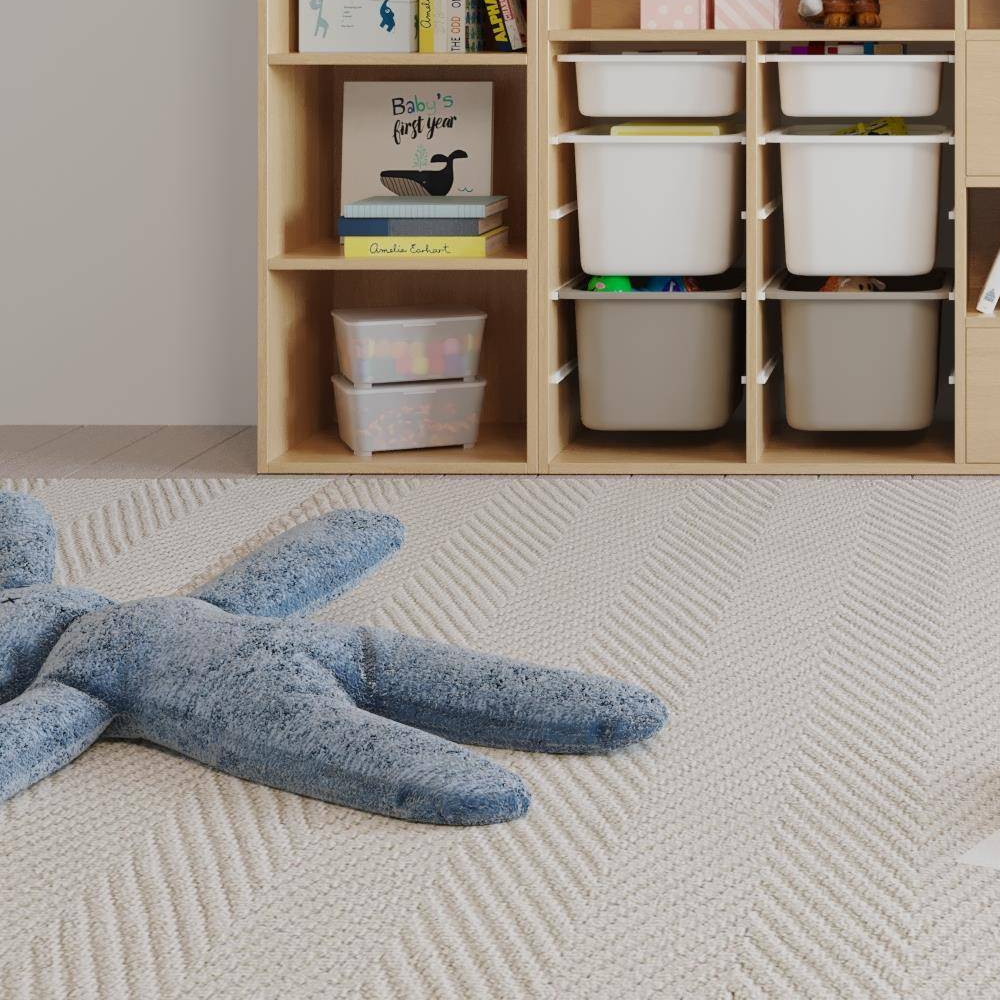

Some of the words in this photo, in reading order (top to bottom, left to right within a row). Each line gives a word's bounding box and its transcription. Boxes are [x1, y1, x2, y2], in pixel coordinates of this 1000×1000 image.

[451, 16, 461, 34] ODD
[451, 37, 461, 52] THE
[391, 92, 455, 116] Baby's
[392, 116, 425, 145] first
[427, 115, 457, 140] year
